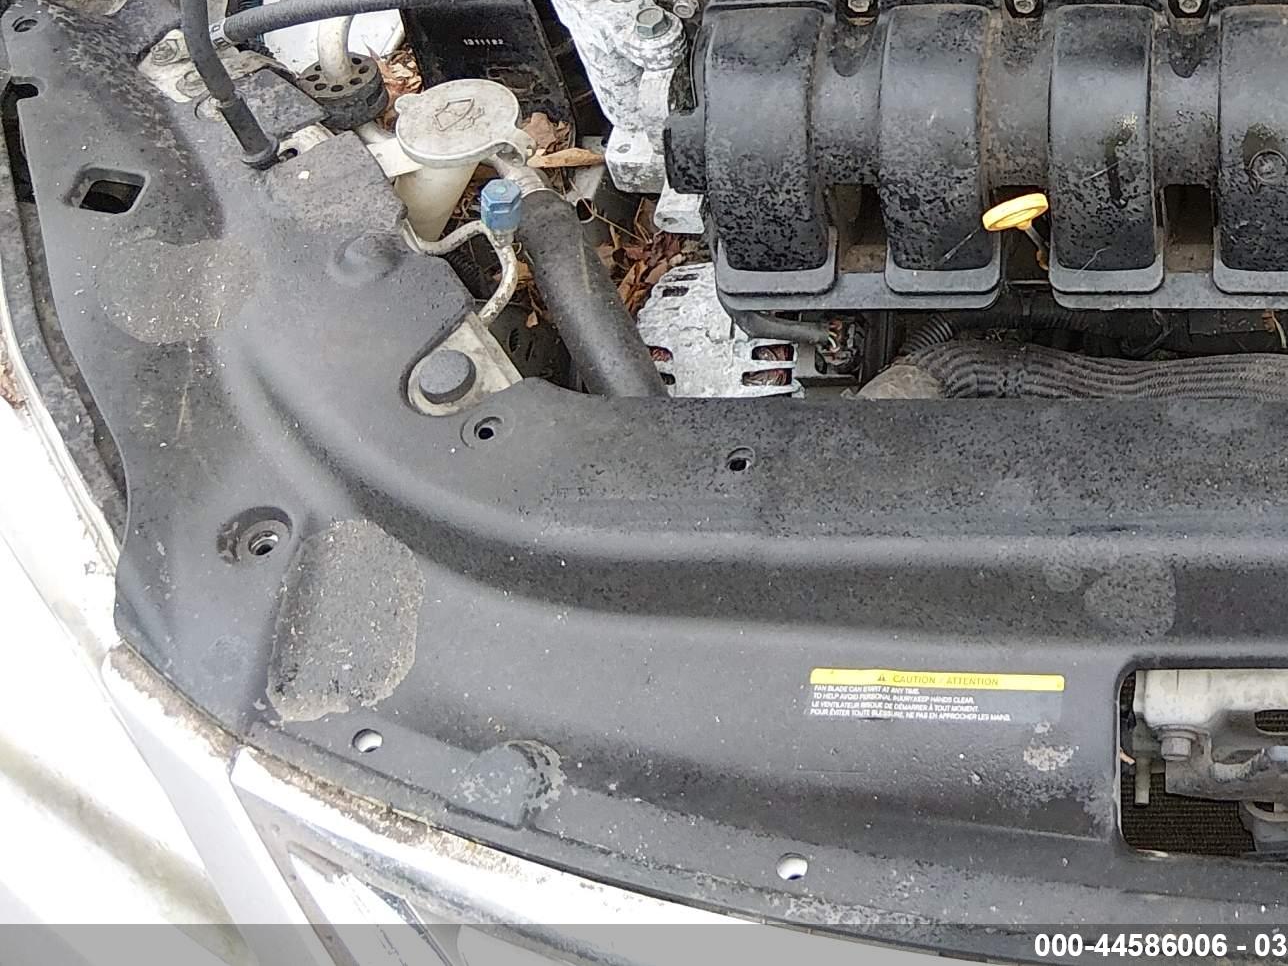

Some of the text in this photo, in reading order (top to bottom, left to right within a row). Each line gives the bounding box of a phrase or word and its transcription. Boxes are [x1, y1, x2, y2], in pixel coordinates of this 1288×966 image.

[893, 675, 936, 684] CAUTION
[946, 676, 998, 686] ATTENTION
[860, 693, 891, 701] PERSONAL
[821, 701, 860, 709] VENTILATEUR
[938, 712, 977, 720] APPROCHER
